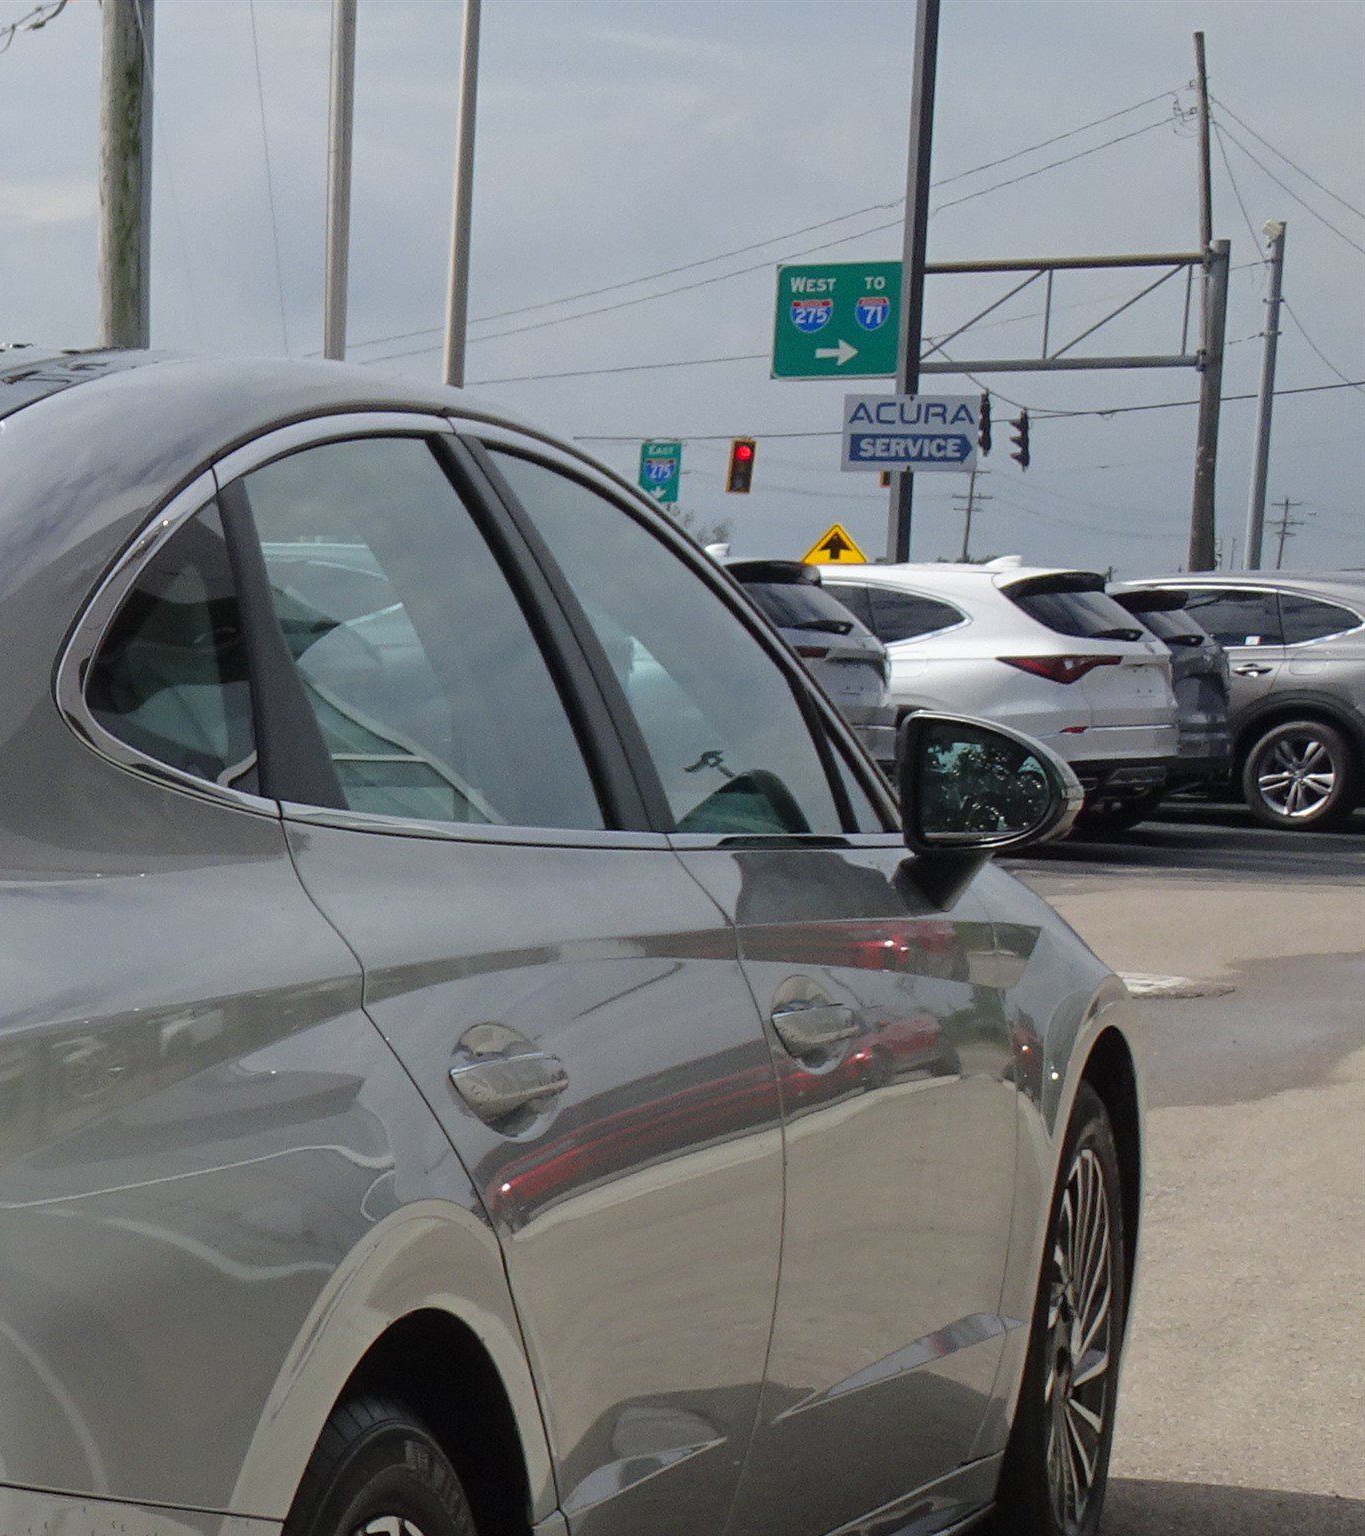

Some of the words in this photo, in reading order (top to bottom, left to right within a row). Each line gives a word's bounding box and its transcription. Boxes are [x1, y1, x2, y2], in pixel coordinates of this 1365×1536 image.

[790, 276, 837, 293] WEST
[864, 276, 886, 290] TO
[795, 307, 828, 324] 275
[863, 306, 883, 324] 71
[848, 402, 975, 425] ACURA
[859, 437, 962, 459] SERVICE
[651, 464, 672, 479] 275
